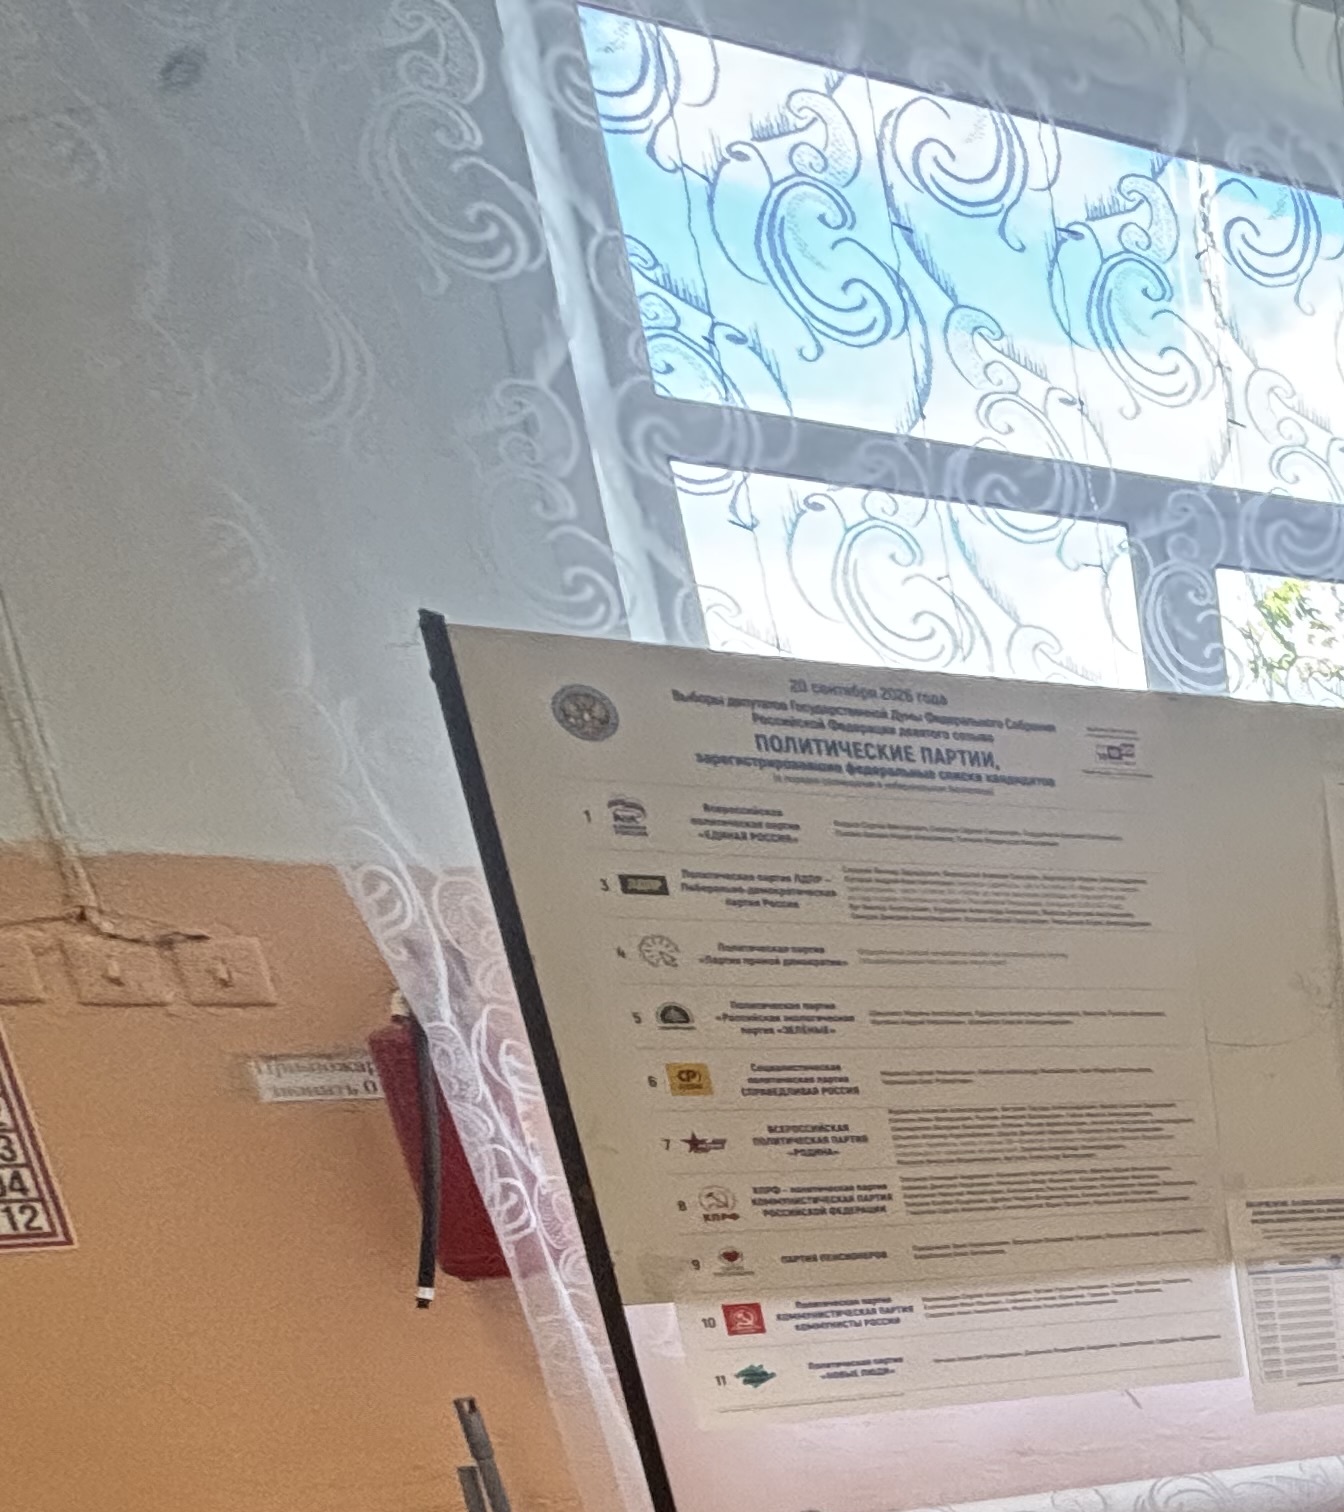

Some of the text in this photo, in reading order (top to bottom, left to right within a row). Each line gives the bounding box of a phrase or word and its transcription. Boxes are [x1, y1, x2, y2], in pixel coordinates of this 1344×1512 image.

[671, 689, 724, 706] Выборы
[811, 683, 877, 700] сентября
[916, 692, 948, 706] года
[754, 733, 1000, 770] ПОЛИТИЧЕСКИЕ ПАРТИИ,
[584, 809, 591, 823] 1
[600, 878, 609, 892] 3
[616, 947, 626, 959] 4
[632, 1012, 642, 1025] 5
[647, 1075, 657, 1088] 6
[661, 1138, 671, 1151] 7
[677, 1200, 687, 1212] 8
[691, 1259, 700, 1270] 9
[701, 1317, 716, 1329] 10
[715, 1375, 727, 1387] 11
